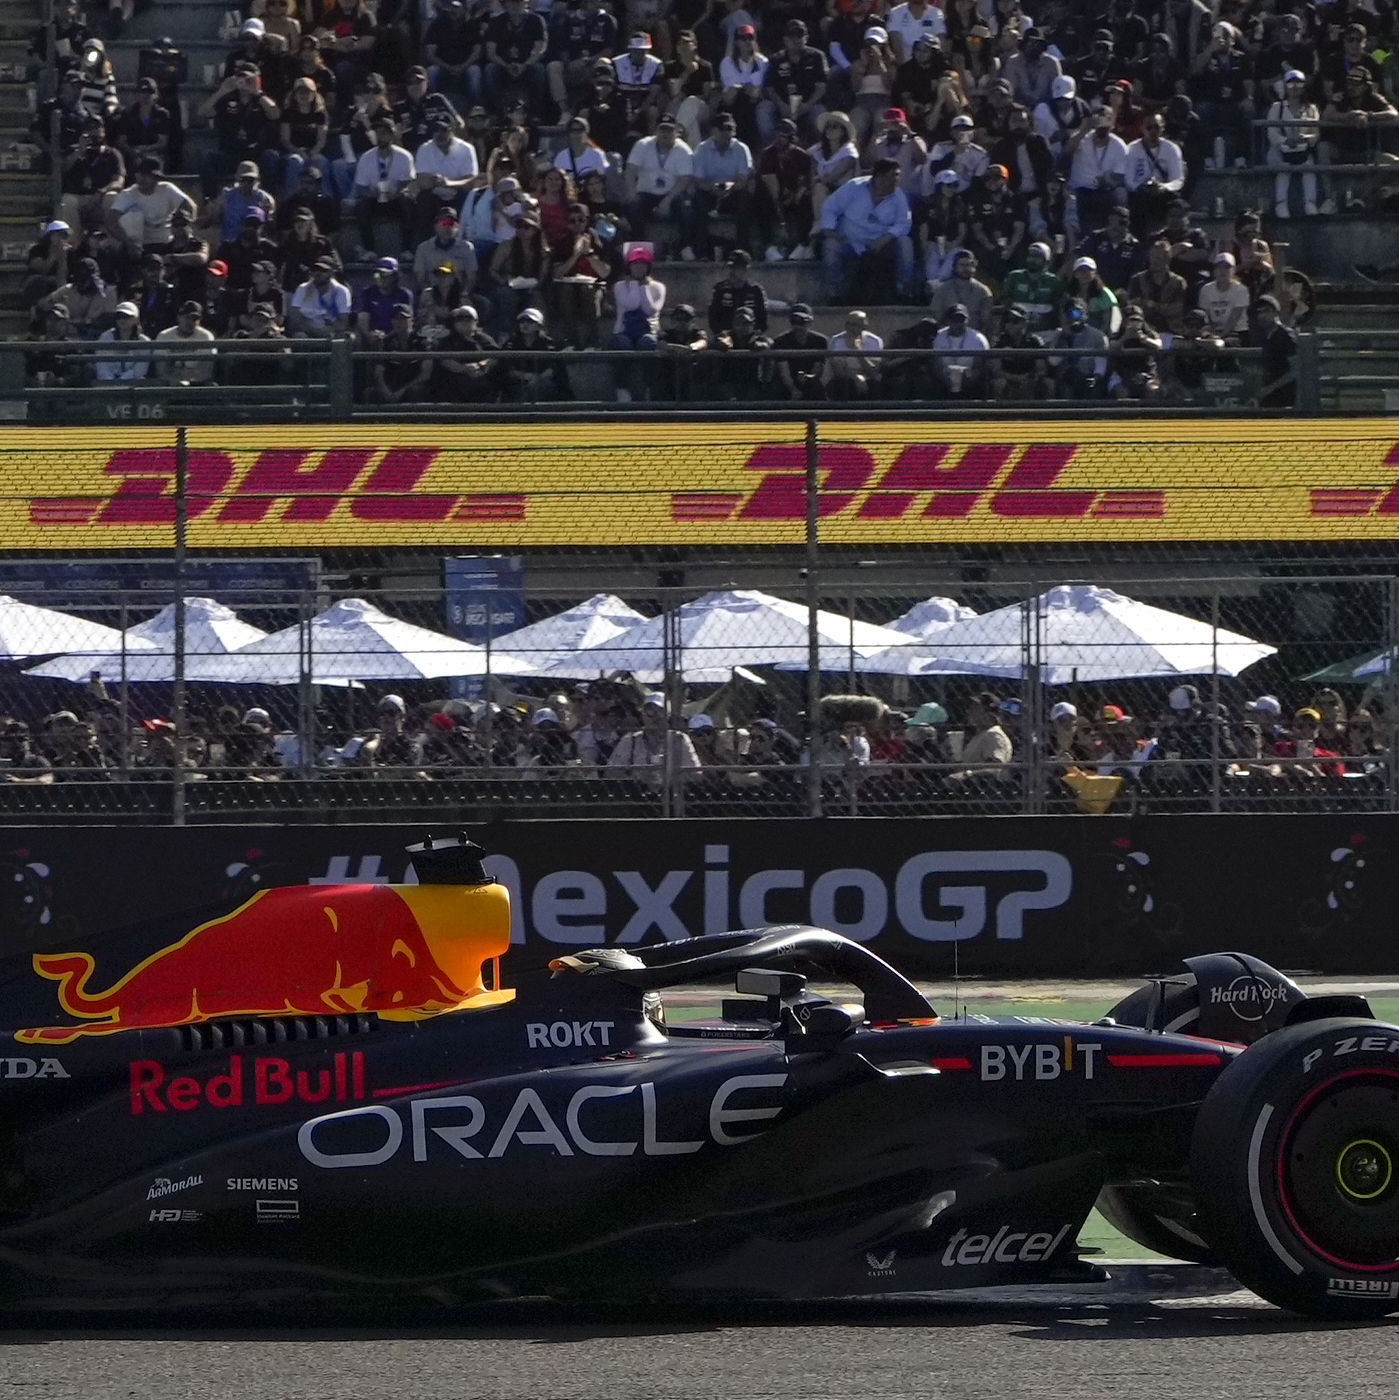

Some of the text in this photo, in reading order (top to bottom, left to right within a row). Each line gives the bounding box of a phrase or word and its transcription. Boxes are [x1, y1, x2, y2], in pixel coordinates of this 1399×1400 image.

[96, 447, 459, 523] DHL
[739, 443, 1098, 520] DHL
[311, 844, 1073, 944] exicoGP
[1210, 984, 1249, 1004] Hard
[526, 1020, 615, 1050] ROKT
[980, 1036, 1103, 1082] BYBIT
[1303, 1048, 1323, 1074] P
[129, 1050, 365, 1115] Red Bull
[297, 1072, 790, 1169] ORACLE
[226, 1177, 299, 1191] SIEMENS
[941, 1223, 1072, 1267] telcel
[1327, 1277, 1399, 1300] PIRELLI
